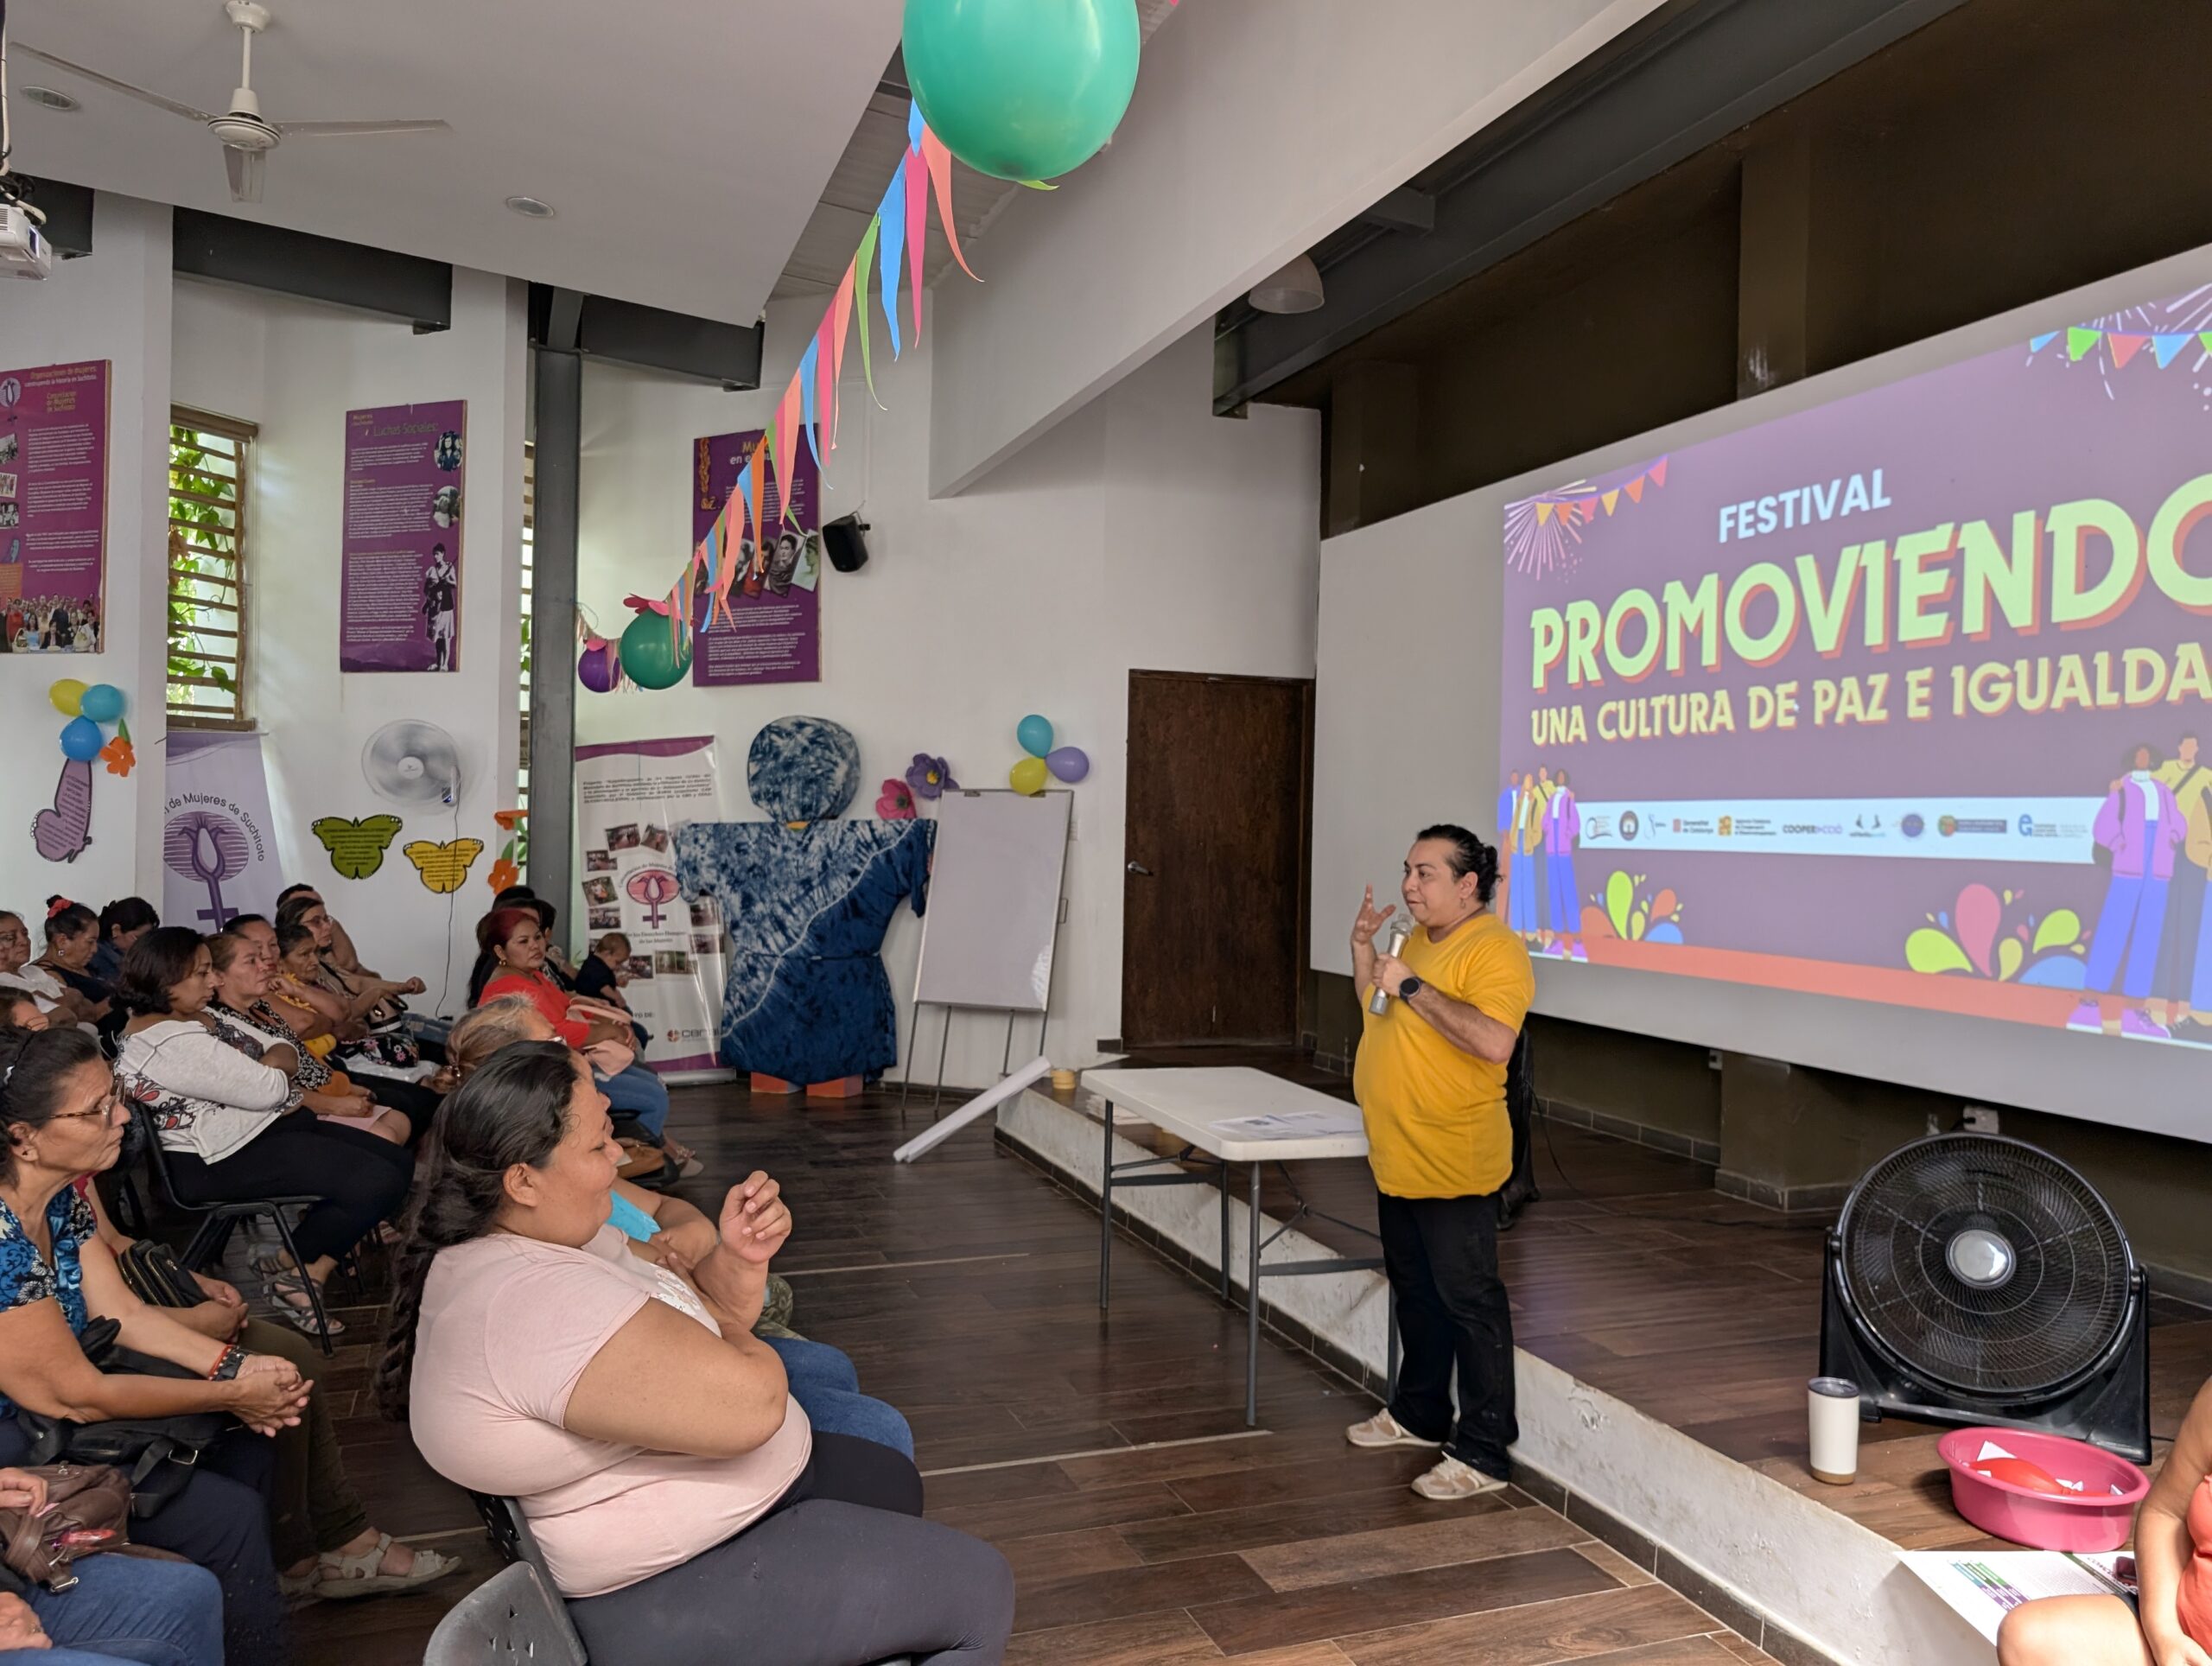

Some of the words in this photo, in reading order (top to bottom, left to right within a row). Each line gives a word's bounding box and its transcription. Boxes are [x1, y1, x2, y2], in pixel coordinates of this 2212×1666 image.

[729, 455, 742, 465] en
[1719, 469, 1891, 543] FESTIVAL
[1530, 473, 2212, 692] PROMOVIENDO
[1531, 705, 1588, 747] UNA
[1597, 689, 1736, 741] CULTURA
[1747, 681, 1798, 731] DE
[1813, 672, 1890, 725] PAZ
[1905, 666, 1934, 720] E
[168, 798, 181, 809] de
[182, 792, 226, 808] Mujeres
[228, 803, 239, 815] de
[240, 812, 264, 862] Suchitoto
